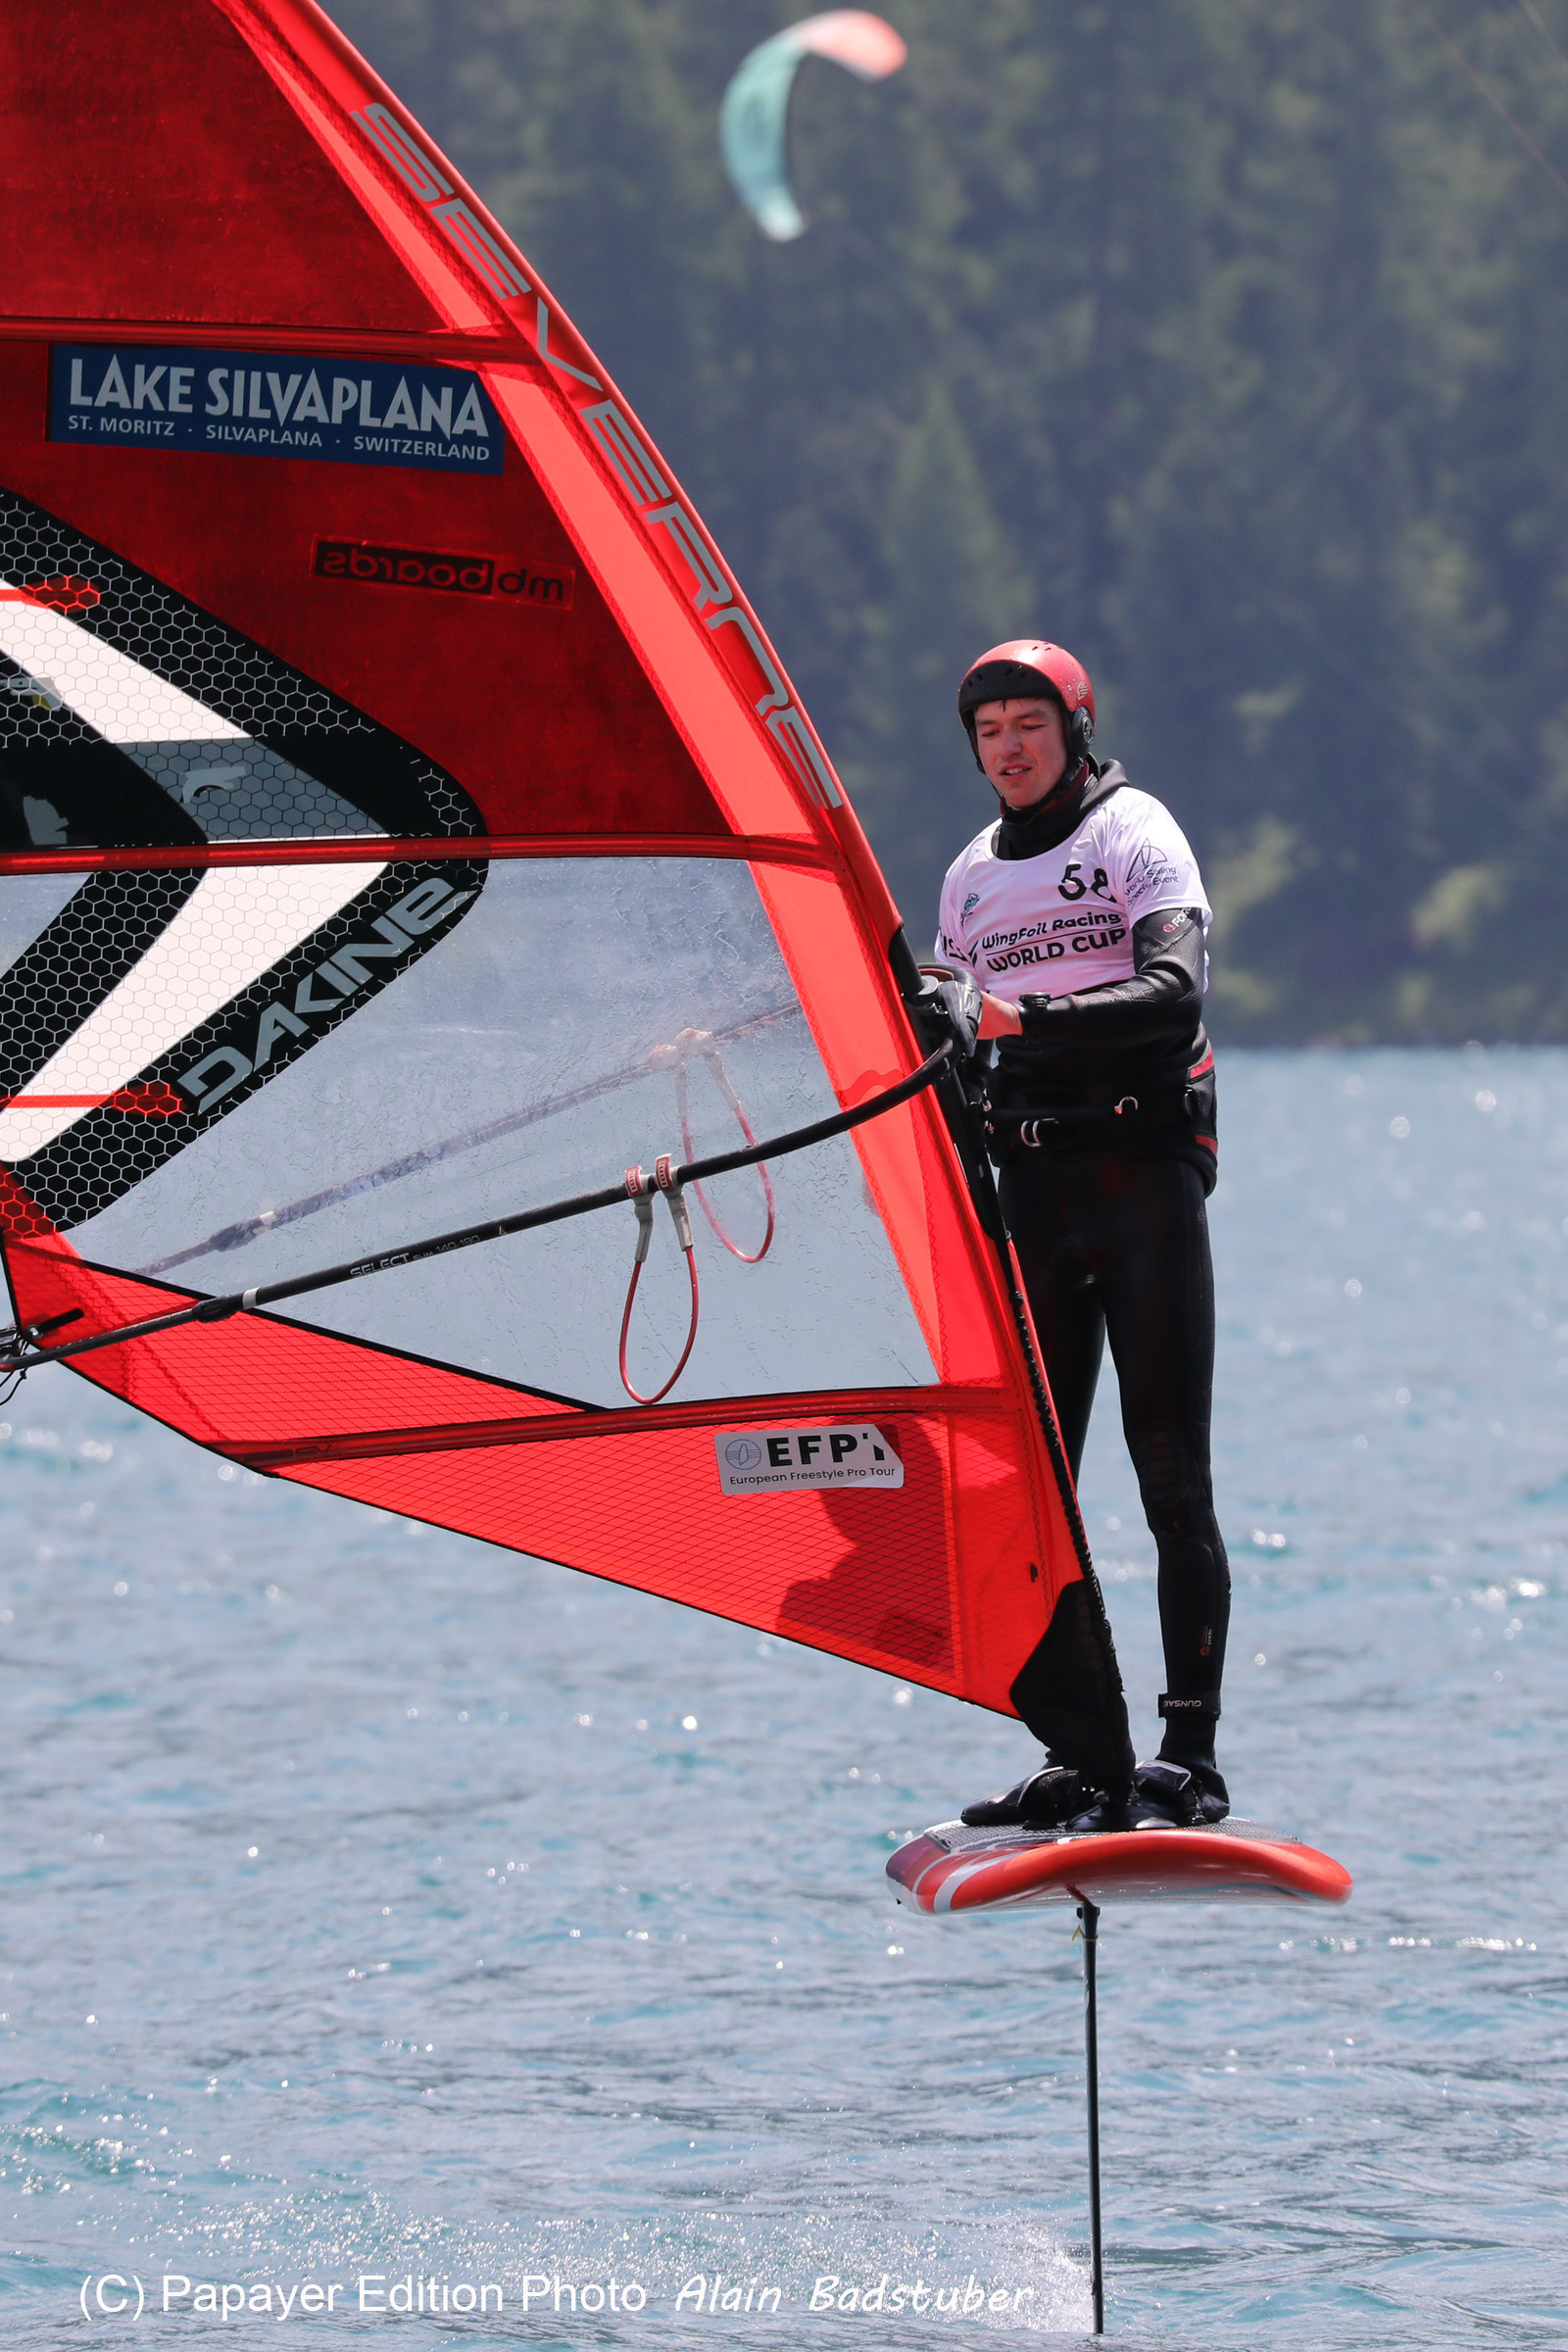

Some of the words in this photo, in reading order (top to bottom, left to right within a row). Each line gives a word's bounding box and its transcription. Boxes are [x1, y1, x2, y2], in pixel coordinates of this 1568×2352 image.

[70, 353, 196, 415] LAKE
[204, 367, 489, 441] SILVAPLANA
[68, 415, 93, 432] ST.
[99, 416, 175, 437] MORITZ
[205, 424, 323, 448] SILVAPLANA
[354, 435, 490, 462] SWITZERLAND
[350, 102, 843, 809] SEVERNE
[1052, 911, 1122, 931] Racing
[987, 942, 1065, 972] WORLD
[1071, 928, 1127, 953] CUP
[182, 877, 477, 1115] DAKINE
[350, 1251, 410, 1277] SELECT
[730, 1473, 787, 1486] European
[790, 1469, 844, 1481] Freestyle
[848, 1468, 867, 1477] Pro
[868, 1467, 896, 1477] Tour
